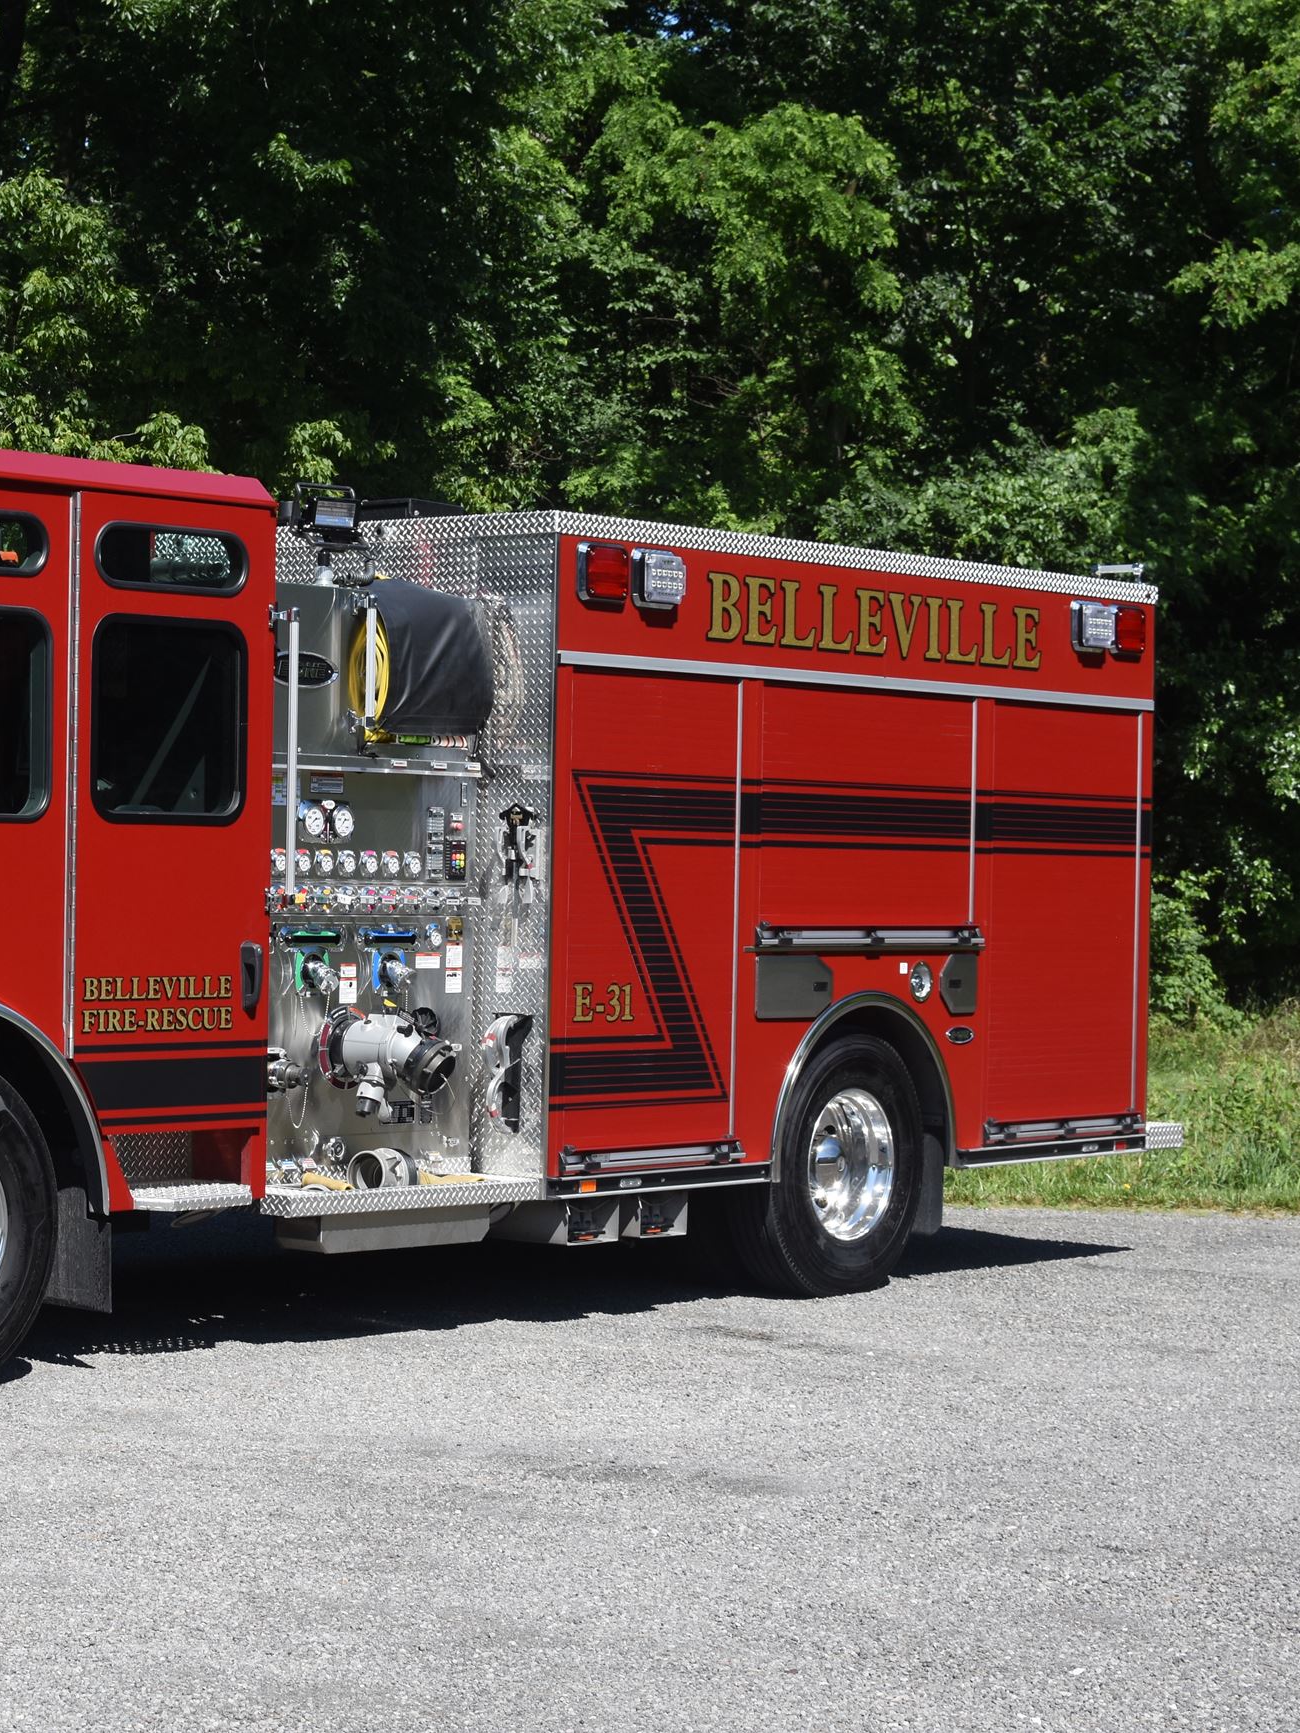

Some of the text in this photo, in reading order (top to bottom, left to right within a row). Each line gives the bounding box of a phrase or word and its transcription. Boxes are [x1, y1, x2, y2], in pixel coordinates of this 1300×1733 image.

[706, 571, 1042, 671] BELLEVILLE
[83, 975, 233, 1001] BELLEVILLE
[572, 982, 634, 1022] E-31
[82, 1007, 233, 1033] FIRE-RESCUE
